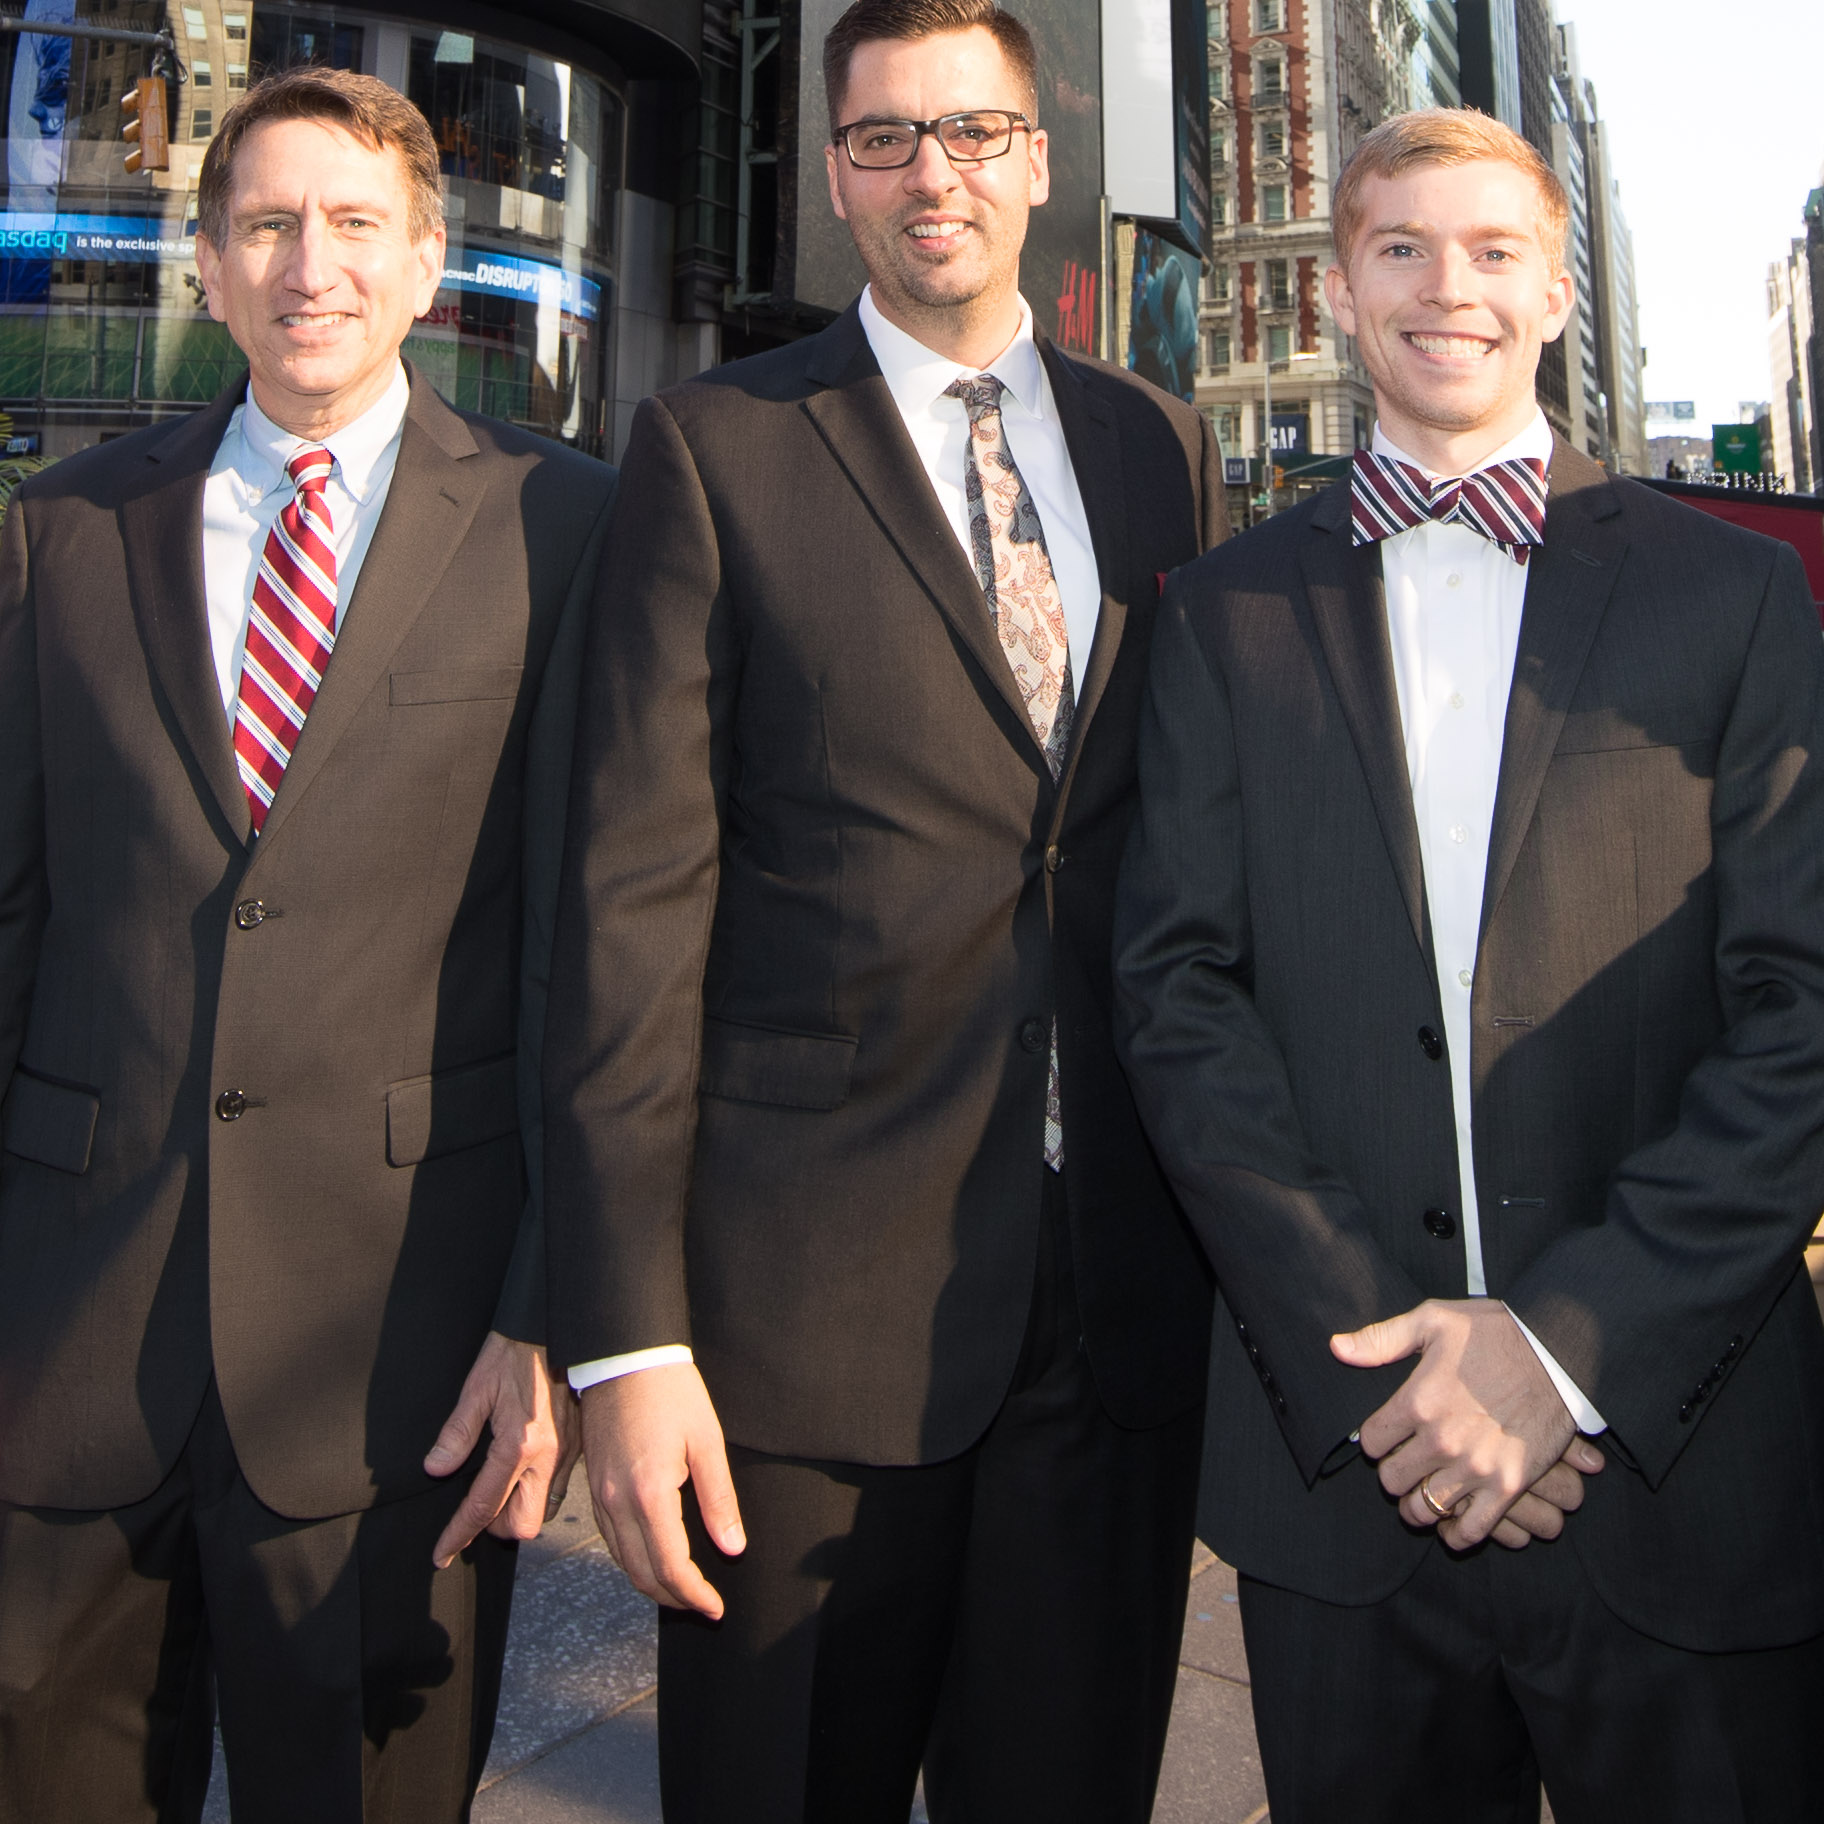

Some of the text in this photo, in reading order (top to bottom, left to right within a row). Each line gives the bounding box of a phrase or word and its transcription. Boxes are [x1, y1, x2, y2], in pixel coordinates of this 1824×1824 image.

[76, 236, 88, 249] is
[90, 236, 113, 250] the
[115, 237, 175, 252] exclusive
[1057, 259, 1096, 357] H&M
[1269, 426, 1297, 450] GAP
